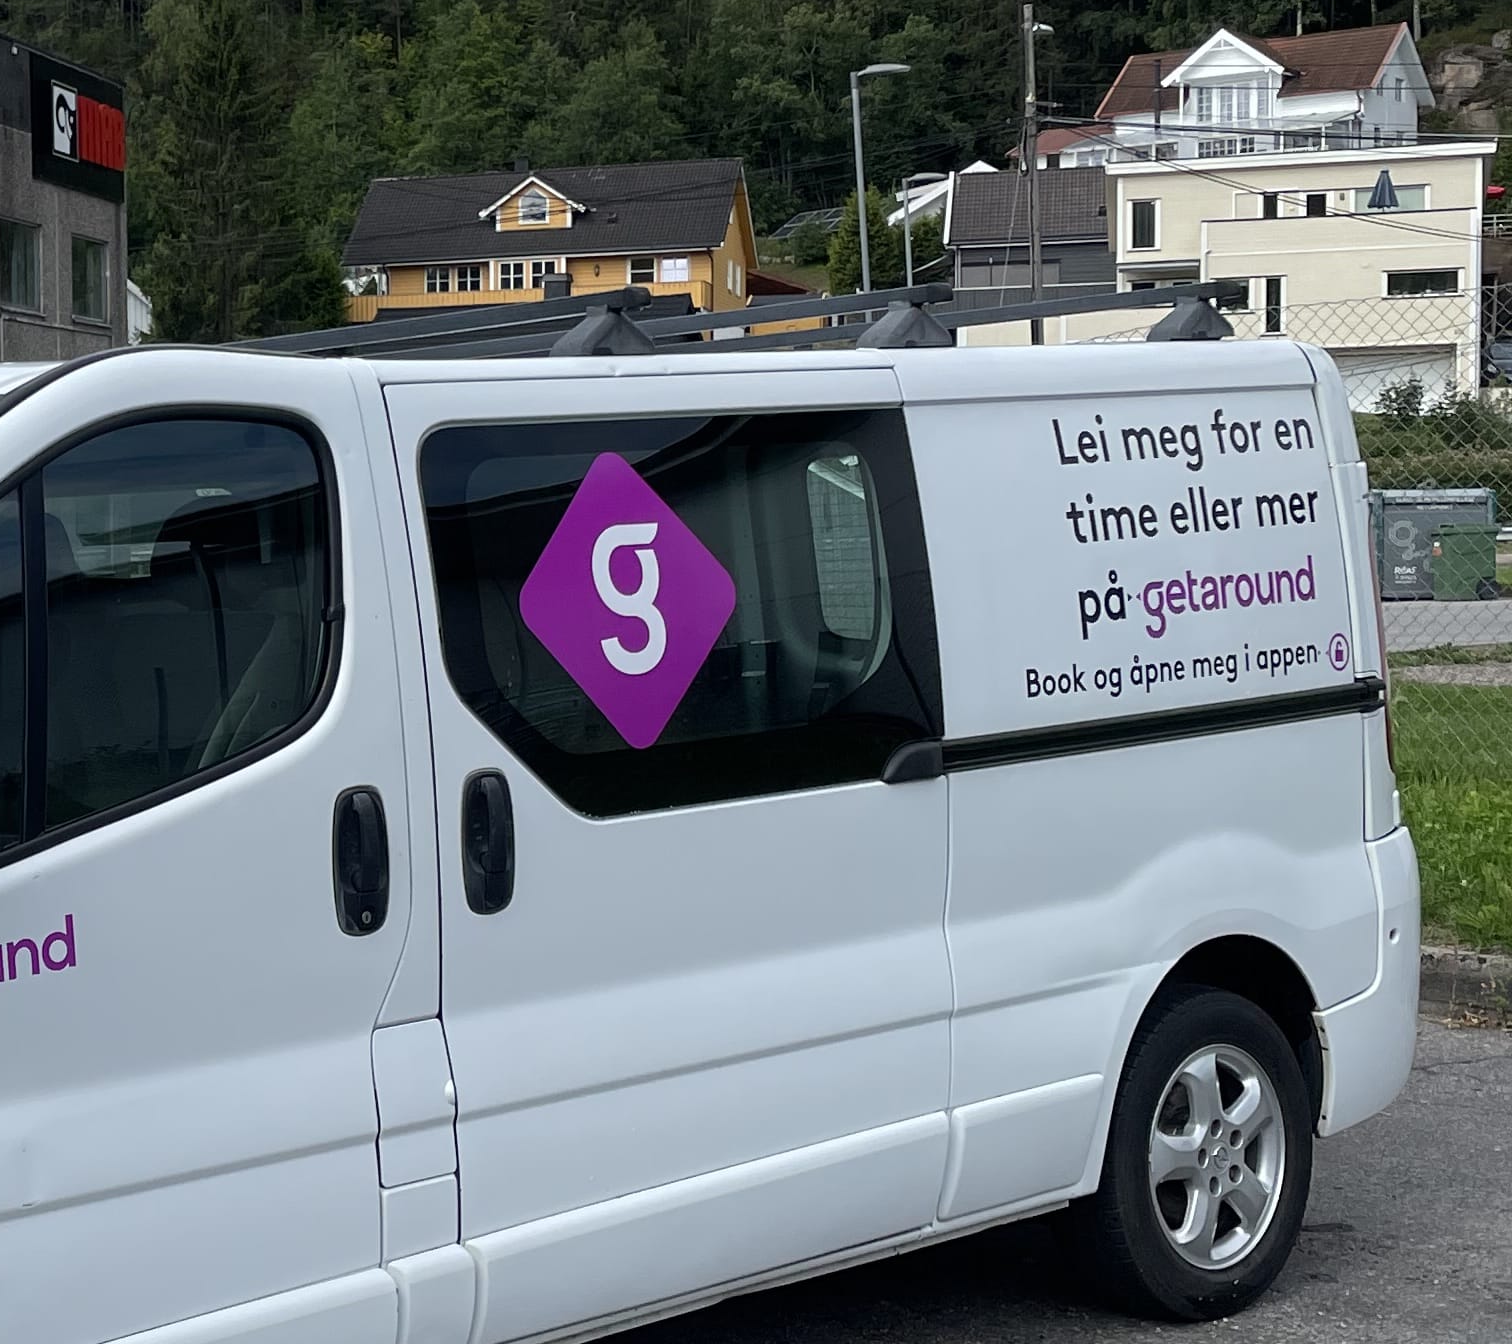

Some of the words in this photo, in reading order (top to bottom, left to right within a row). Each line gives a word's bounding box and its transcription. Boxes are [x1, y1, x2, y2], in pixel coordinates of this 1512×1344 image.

[1052, 414, 1110, 465] Lei
[1121, 424, 1204, 471] meg
[1211, 409, 1261, 454] for
[1275, 417, 1314, 450] en
[1066, 493, 1158, 544] time
[1170, 486, 1243, 534] eller
[1256, 491, 1318, 527] mer
[591, 522, 667, 675] g
[1078, 570, 1126, 640] på
[1143, 555, 1316, 638] getaround
[1025, 664, 1087, 697] Book
[1094, 667, 1122, 697] og
[1131, 655, 1185, 693] åpne
[1192, 653, 1238, 683] meg
[1244, 643, 1250, 672] i
[1256, 643, 1318, 676] appen
